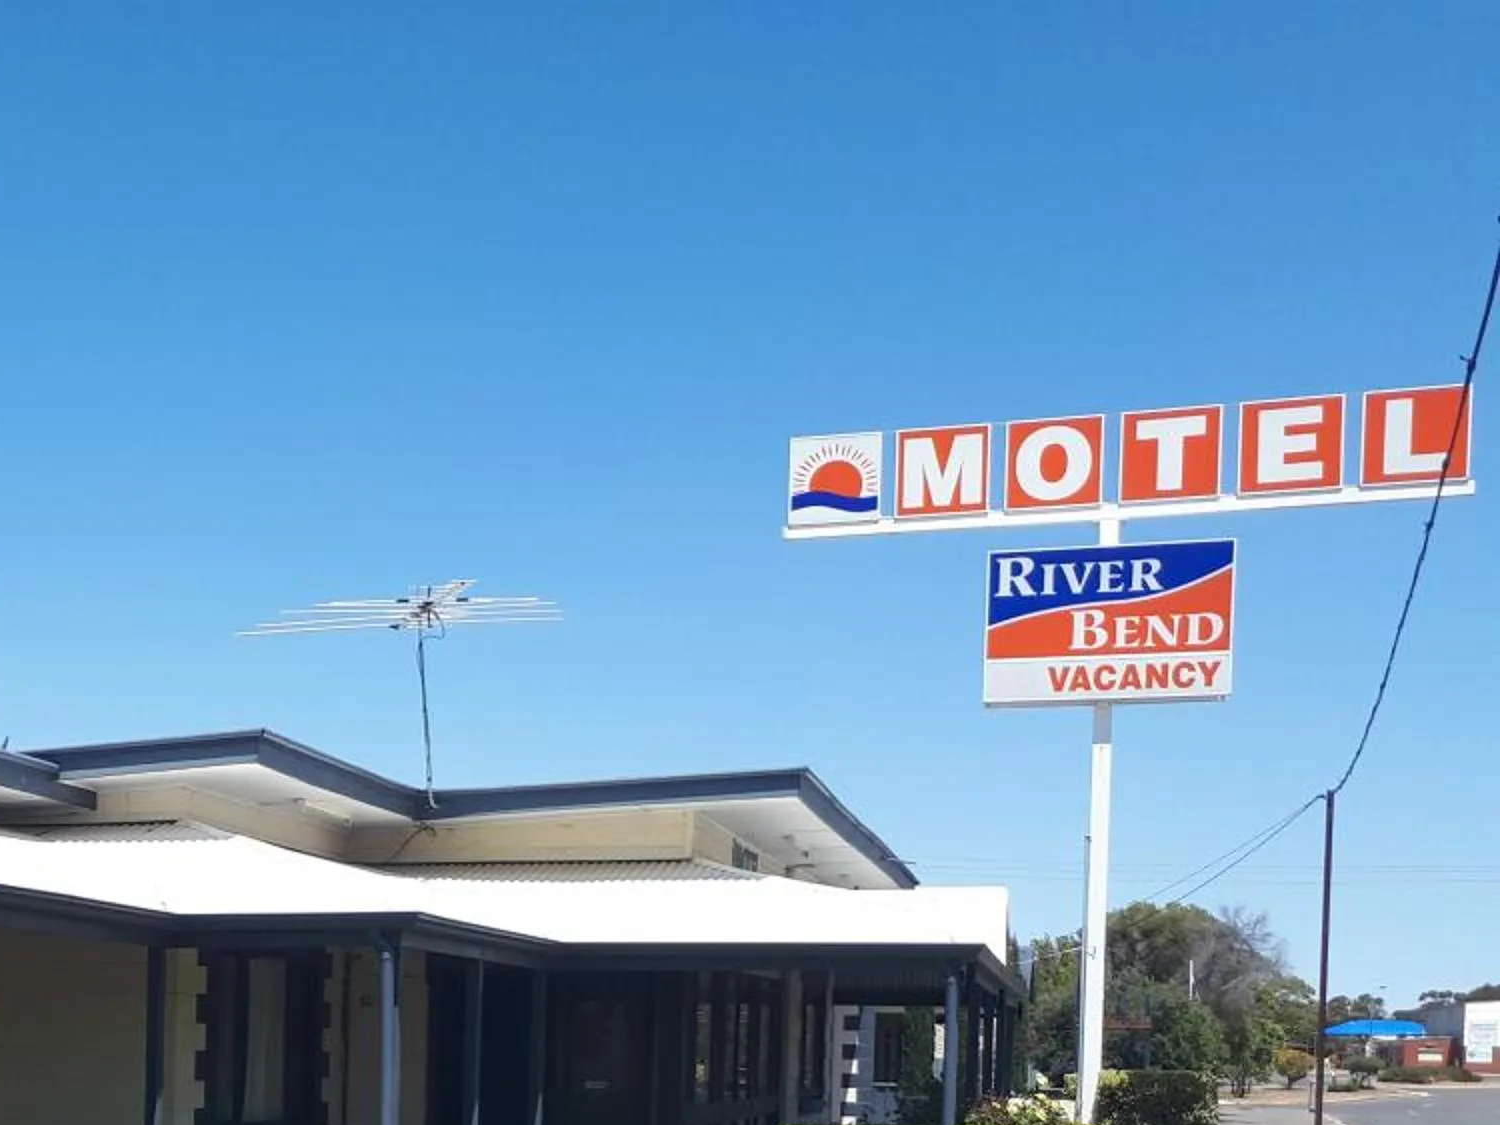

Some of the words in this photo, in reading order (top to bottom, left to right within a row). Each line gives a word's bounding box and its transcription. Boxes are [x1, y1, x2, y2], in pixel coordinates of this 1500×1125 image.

[902, 398, 1447, 509] MOTEL
[995, 557, 1163, 597] RIVER
[1071, 610, 1224, 650] BEND
[1048, 661, 1221, 692] VACANCY
